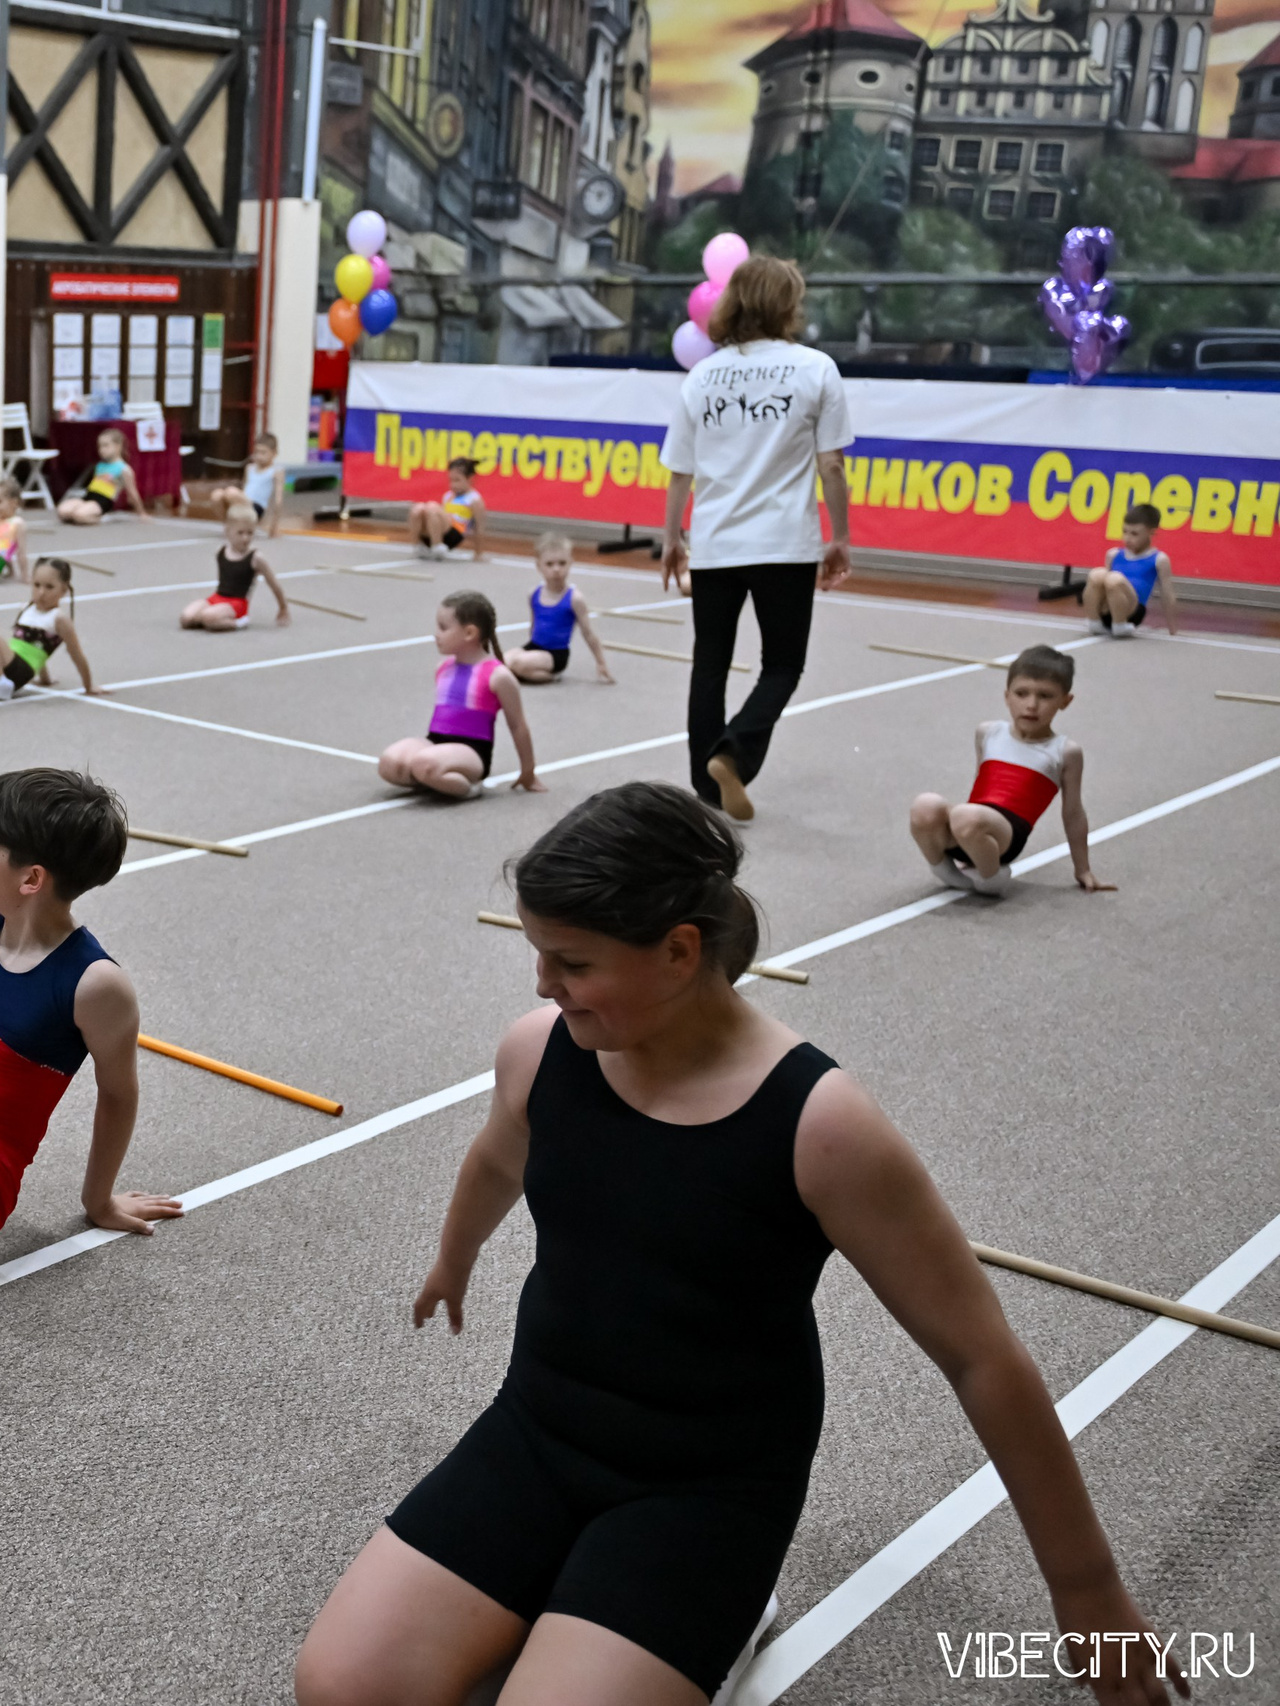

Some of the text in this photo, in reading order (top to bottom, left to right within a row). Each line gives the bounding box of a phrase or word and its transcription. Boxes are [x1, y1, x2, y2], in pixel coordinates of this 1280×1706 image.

[702, 364, 795, 389] Тренер
[374, 413, 673, 497] Приветствуем
[1028, 450, 1280, 541] Соревн
